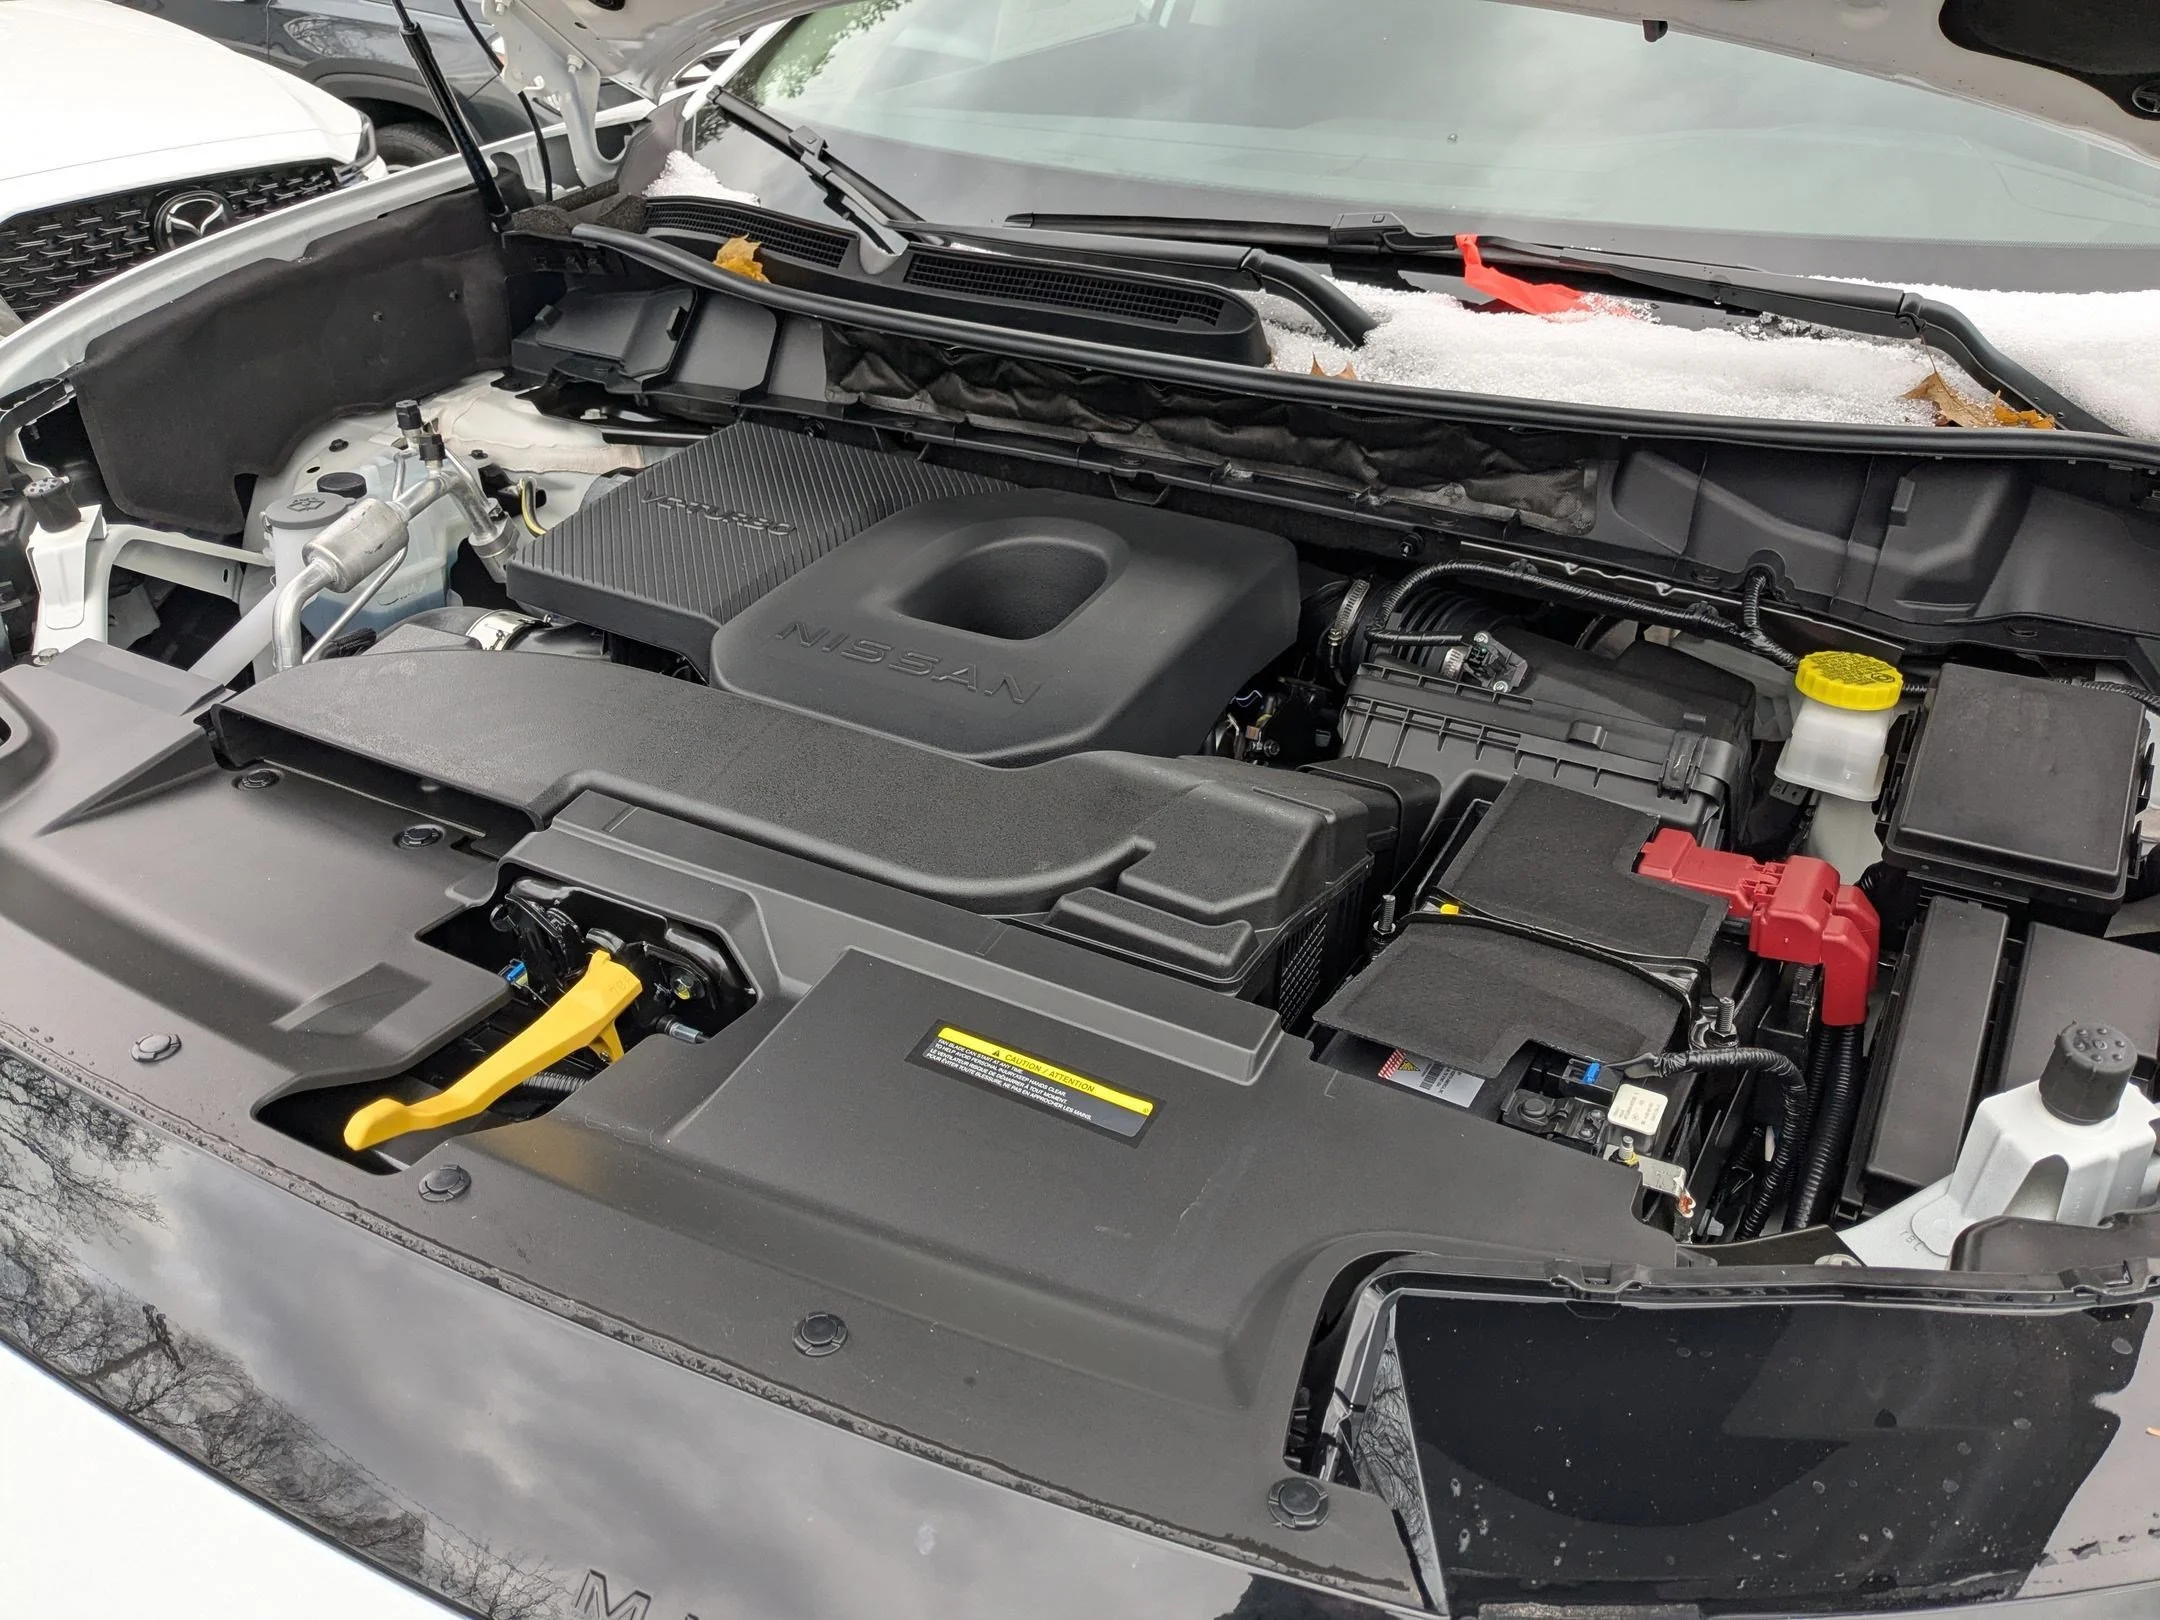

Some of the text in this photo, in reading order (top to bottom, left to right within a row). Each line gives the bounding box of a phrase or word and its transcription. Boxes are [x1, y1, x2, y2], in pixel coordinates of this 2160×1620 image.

[774, 620, 1042, 704] NISSAN
[1004, 1054, 1041, 1072] CAUTION
[1049, 1071, 1094, 1092] ATTENTION
